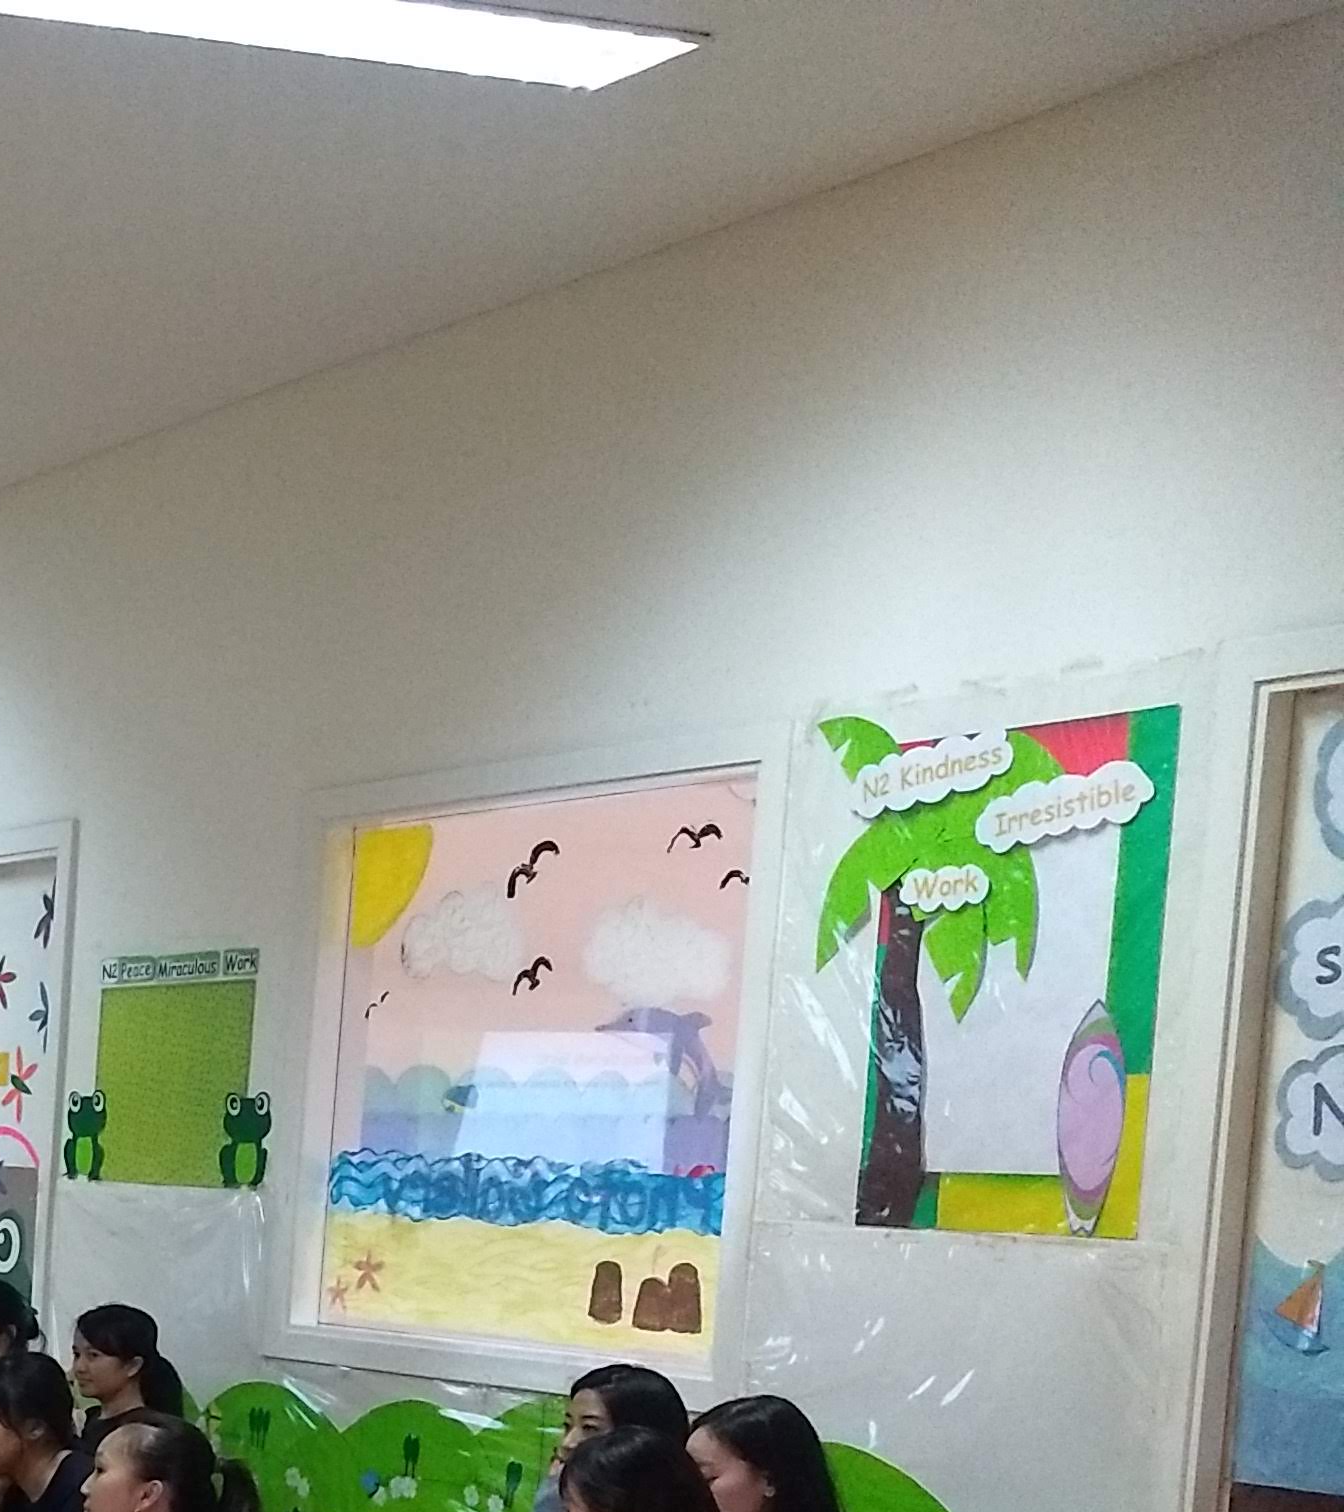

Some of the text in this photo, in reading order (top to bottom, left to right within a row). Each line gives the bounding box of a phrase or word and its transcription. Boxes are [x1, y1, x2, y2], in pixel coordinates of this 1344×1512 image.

[863, 746, 1004, 798] N2 Kindness
[993, 783, 1137, 834] Irresistible
[913, 874, 978, 899] Work
[102, 952, 257, 980] N2 Peace Miraculous Work
